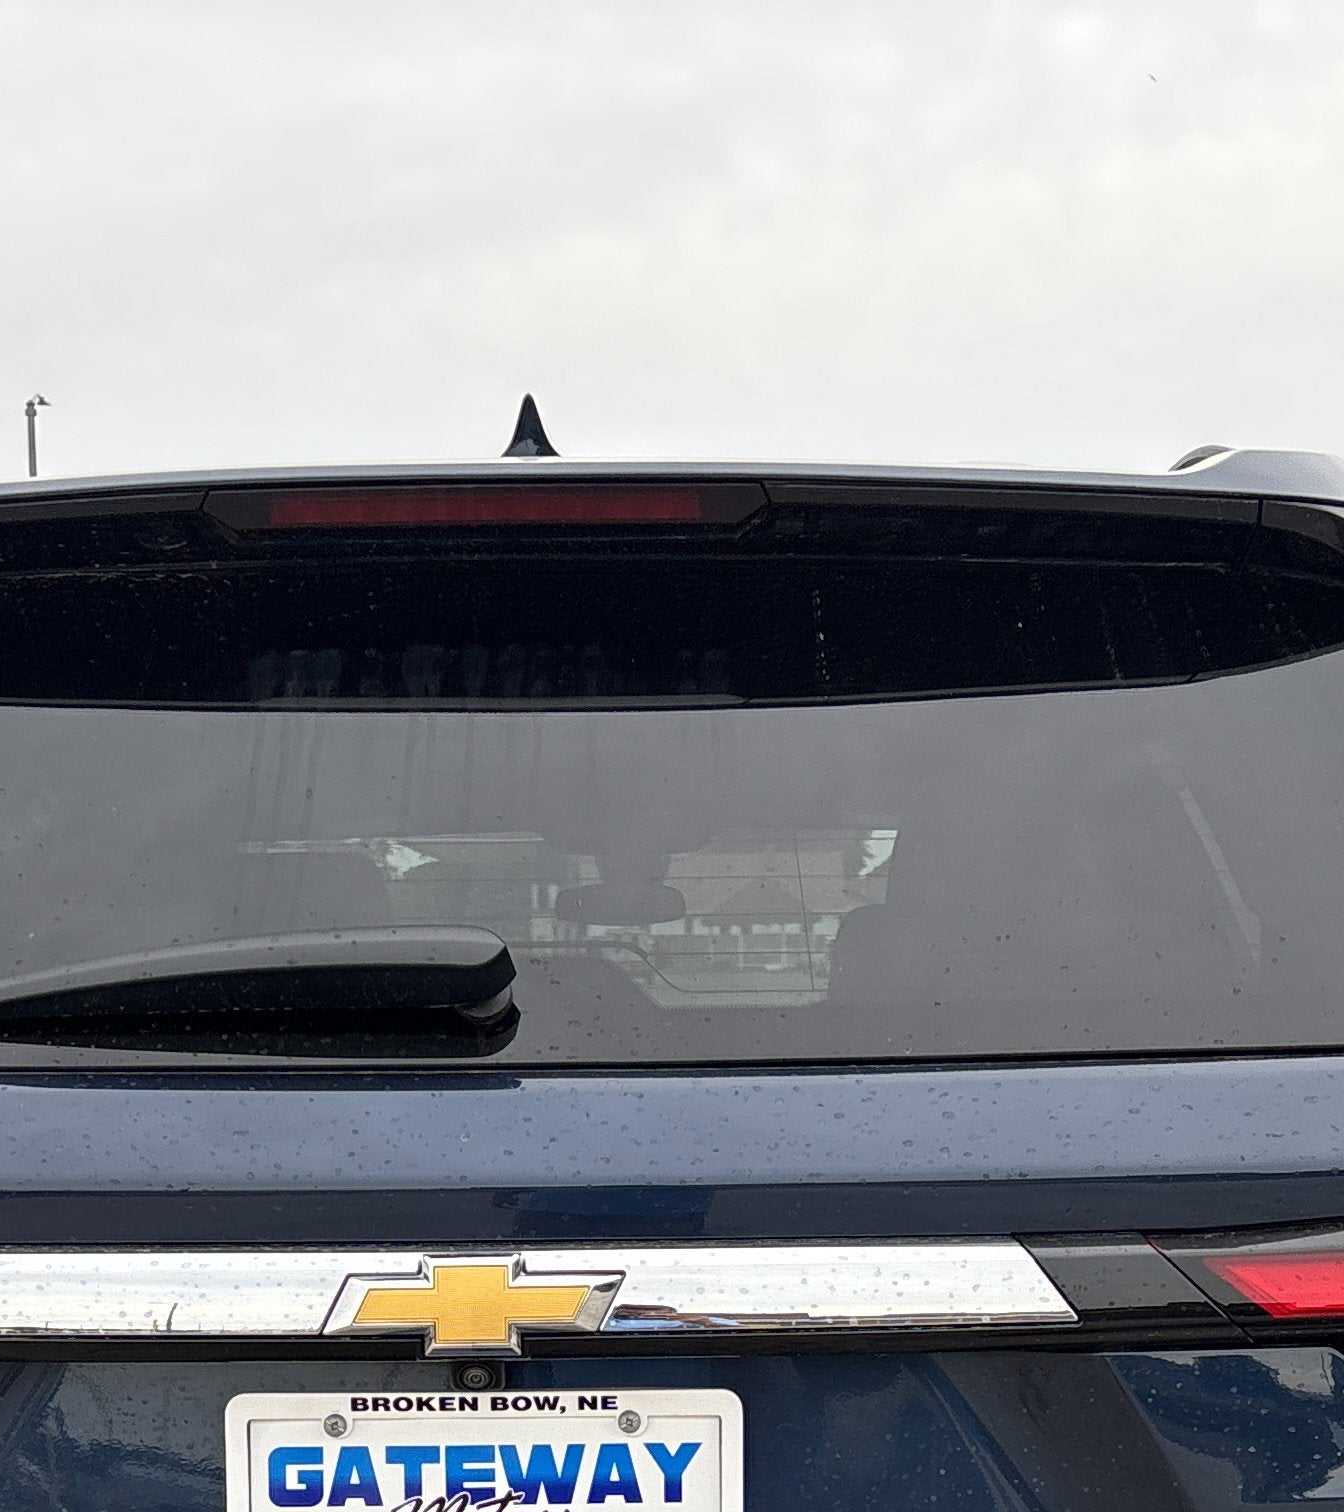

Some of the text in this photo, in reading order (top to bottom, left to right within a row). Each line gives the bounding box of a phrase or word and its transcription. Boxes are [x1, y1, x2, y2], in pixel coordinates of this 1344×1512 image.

[350, 1395, 619, 1415] BROKEN BOW, NE
[267, 1442, 703, 1508] GATEWAY
